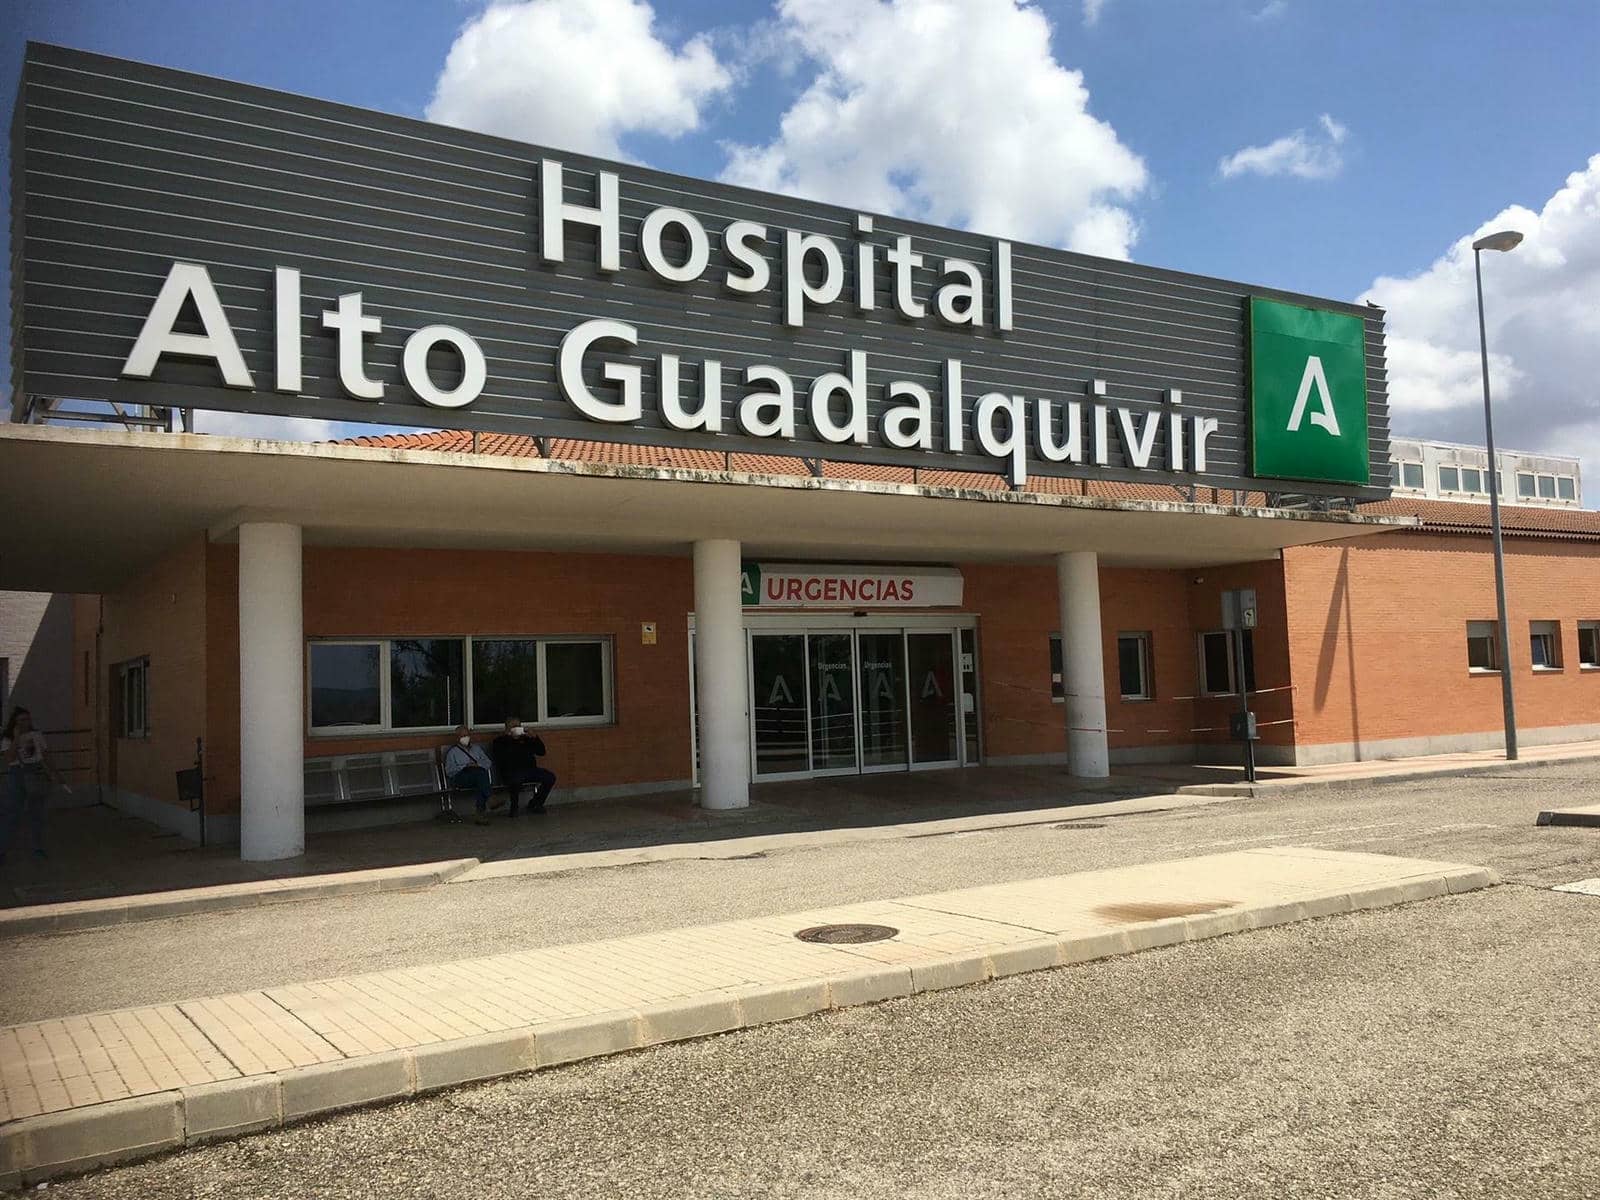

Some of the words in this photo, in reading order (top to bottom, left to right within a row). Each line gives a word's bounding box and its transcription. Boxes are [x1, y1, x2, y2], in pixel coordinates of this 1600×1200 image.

[538, 158, 1014, 332] Hospital
[121, 261, 487, 409] Alto
[557, 318, 1219, 487] Guadalquivir
[1286, 355, 1341, 437] A
[767, 577, 914, 601] URGENCIAS
